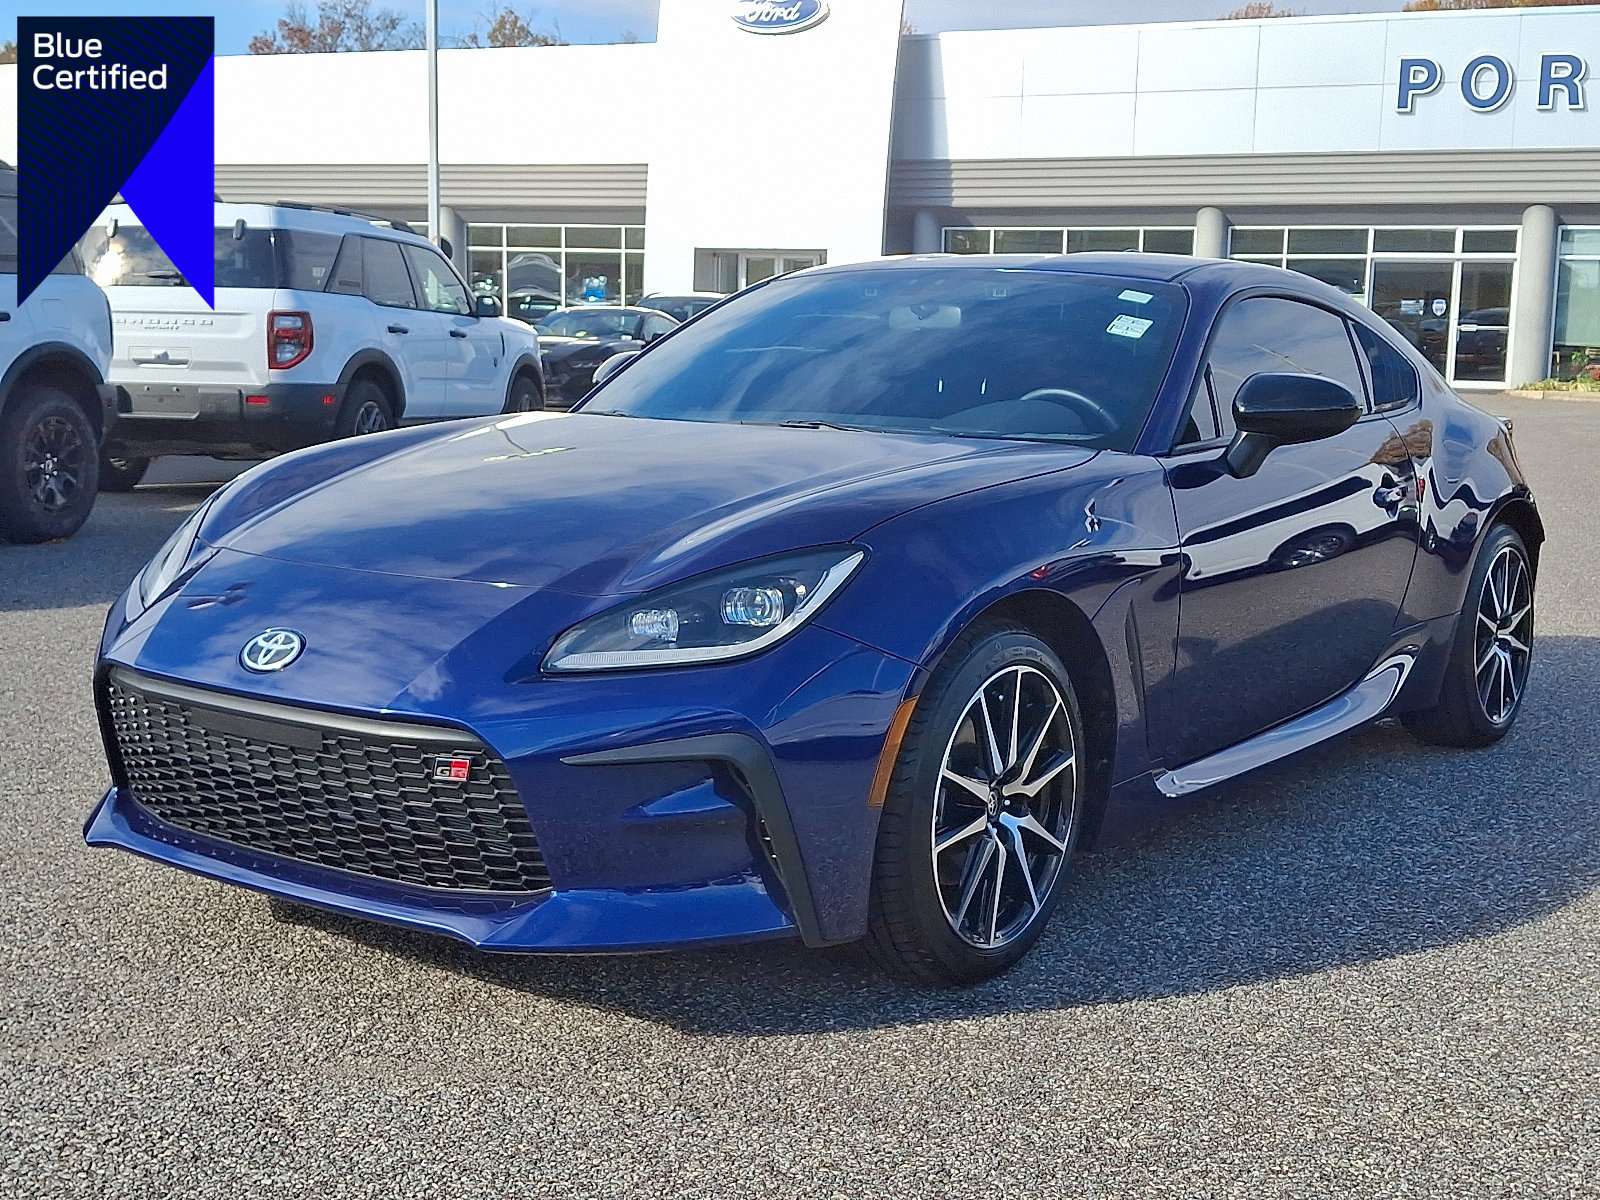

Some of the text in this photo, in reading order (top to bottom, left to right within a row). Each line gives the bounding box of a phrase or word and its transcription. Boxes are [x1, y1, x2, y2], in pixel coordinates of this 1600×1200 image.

[744, 0, 803, 23] Ford
[1395, 51, 1587, 114] POR
[435, 765, 467, 779] GR
